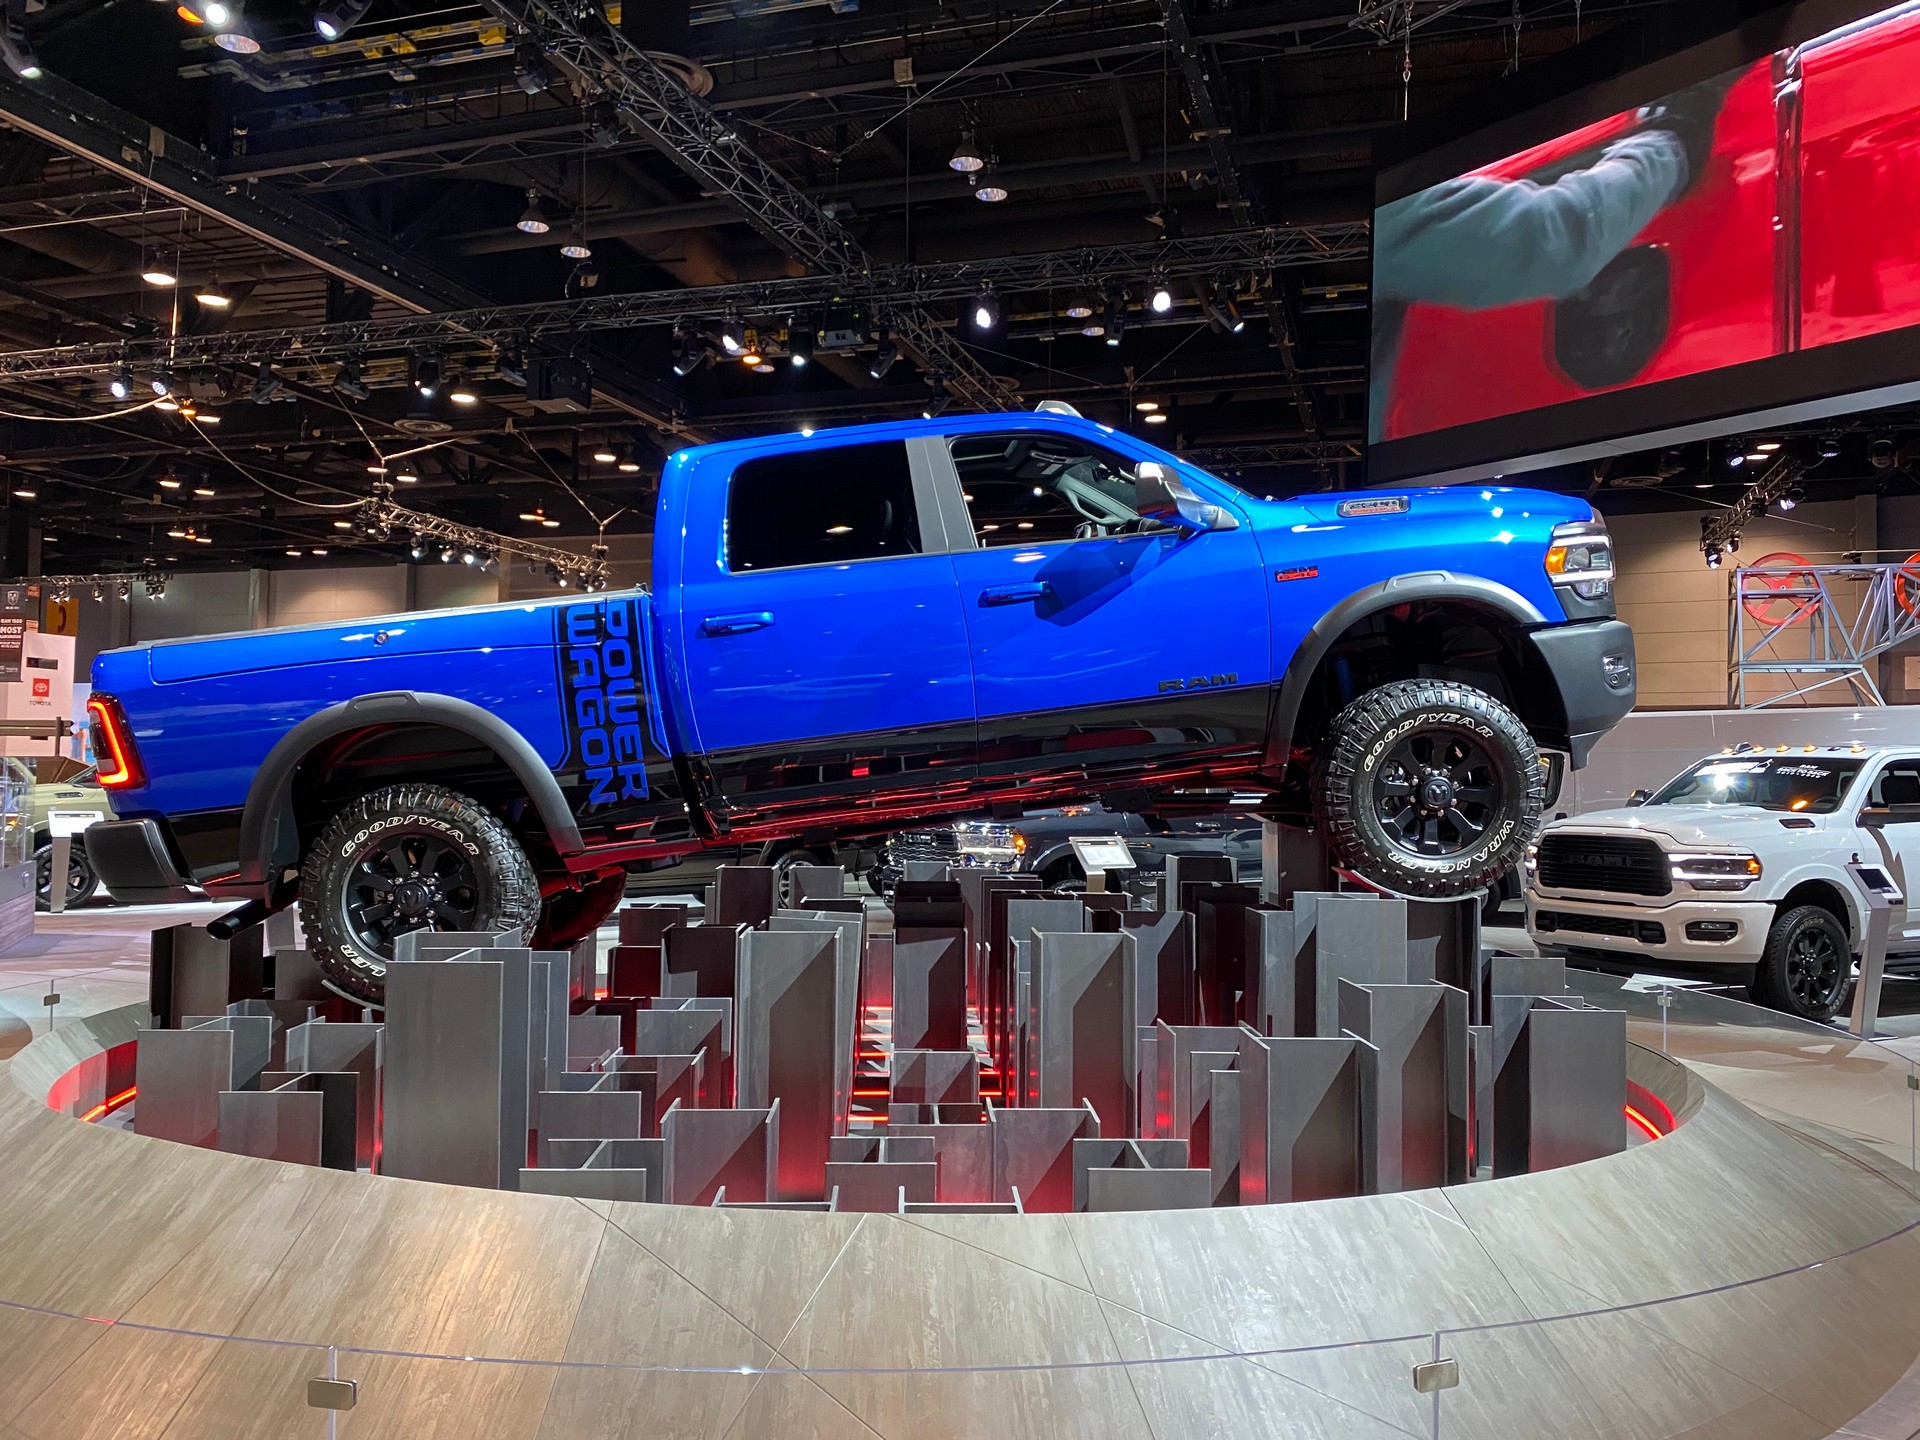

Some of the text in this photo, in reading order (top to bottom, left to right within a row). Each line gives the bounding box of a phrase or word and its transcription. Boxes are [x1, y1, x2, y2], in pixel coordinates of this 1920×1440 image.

[0, 626, 22, 634] MOST
[566, 603, 618, 805] WAGON
[600, 600, 649, 800] POWER
[1157, 672, 1238, 693] RAM
[1363, 712, 1494, 772] GOODYEAR
[341, 814, 480, 858] GOODYEAR
[1386, 819, 1515, 874] WRANGLER
